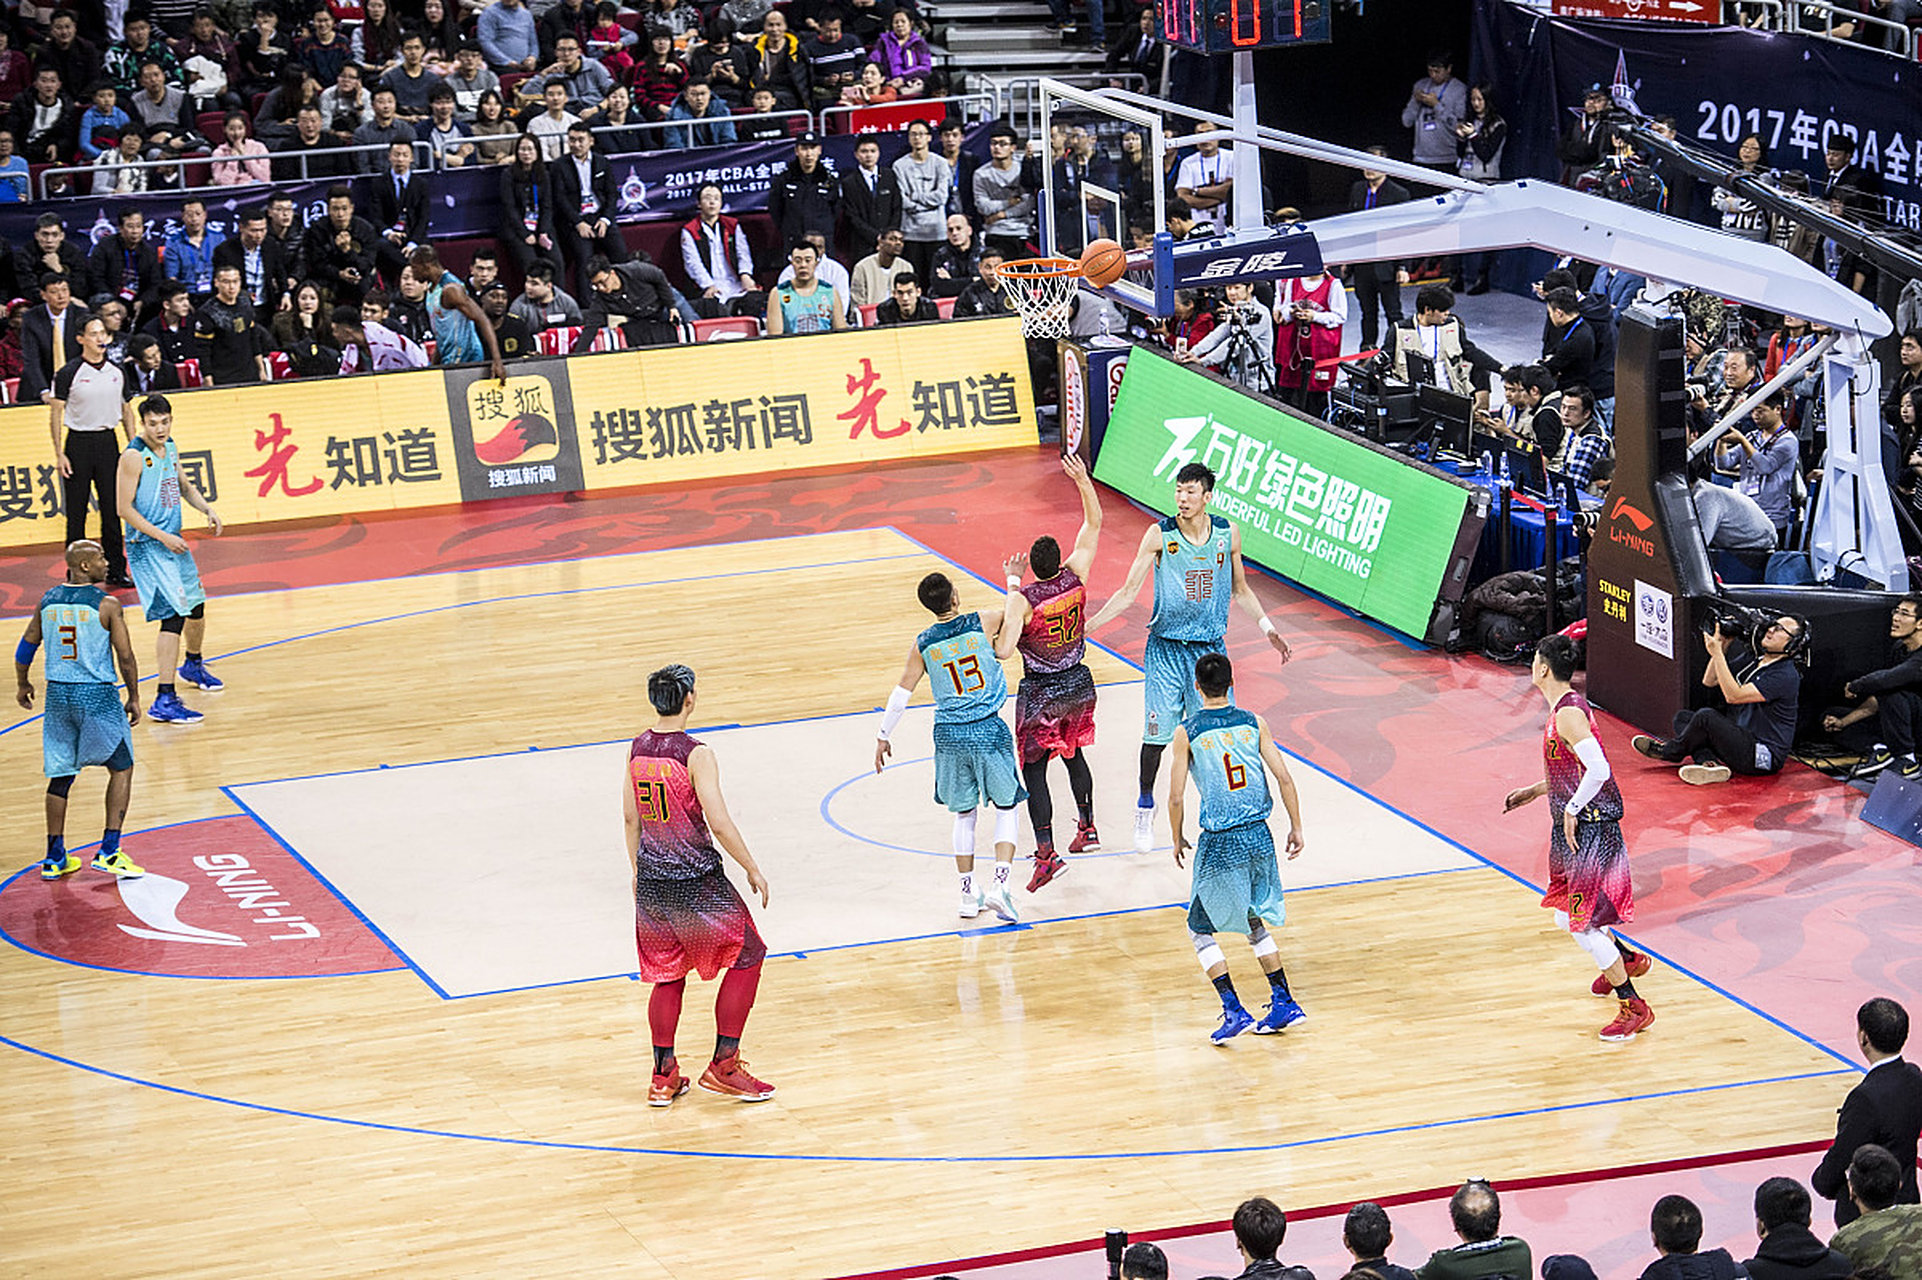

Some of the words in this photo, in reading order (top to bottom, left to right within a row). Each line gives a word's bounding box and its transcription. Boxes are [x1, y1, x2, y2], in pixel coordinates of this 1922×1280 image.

[667, 188, 692, 199] 2017
[722, 181, 771, 193] ALL-STA
[474, 386, 549, 421] 搜狐
[590, 394, 813, 466] 搜狐新闻
[488, 465, 557, 488] 搜狐新闻
[1211, 487, 1271, 534] NDERFUL
[1273, 517, 1301, 546] LED
[1303, 533, 1372, 579] LIGHTING
[1610, 526, 1654, 557] LI-NING
[1216, 552, 1225, 569] 9
[1600, 579, 1631, 603] STANLEY
[59, 625, 77, 661] 3
[1046, 605, 1080, 648] 32
[942, 654, 985, 696] 13
[1223, 752, 1247, 792] 6
[637, 780, 670, 823] 31
[192, 853, 321, 941] LI-NING
